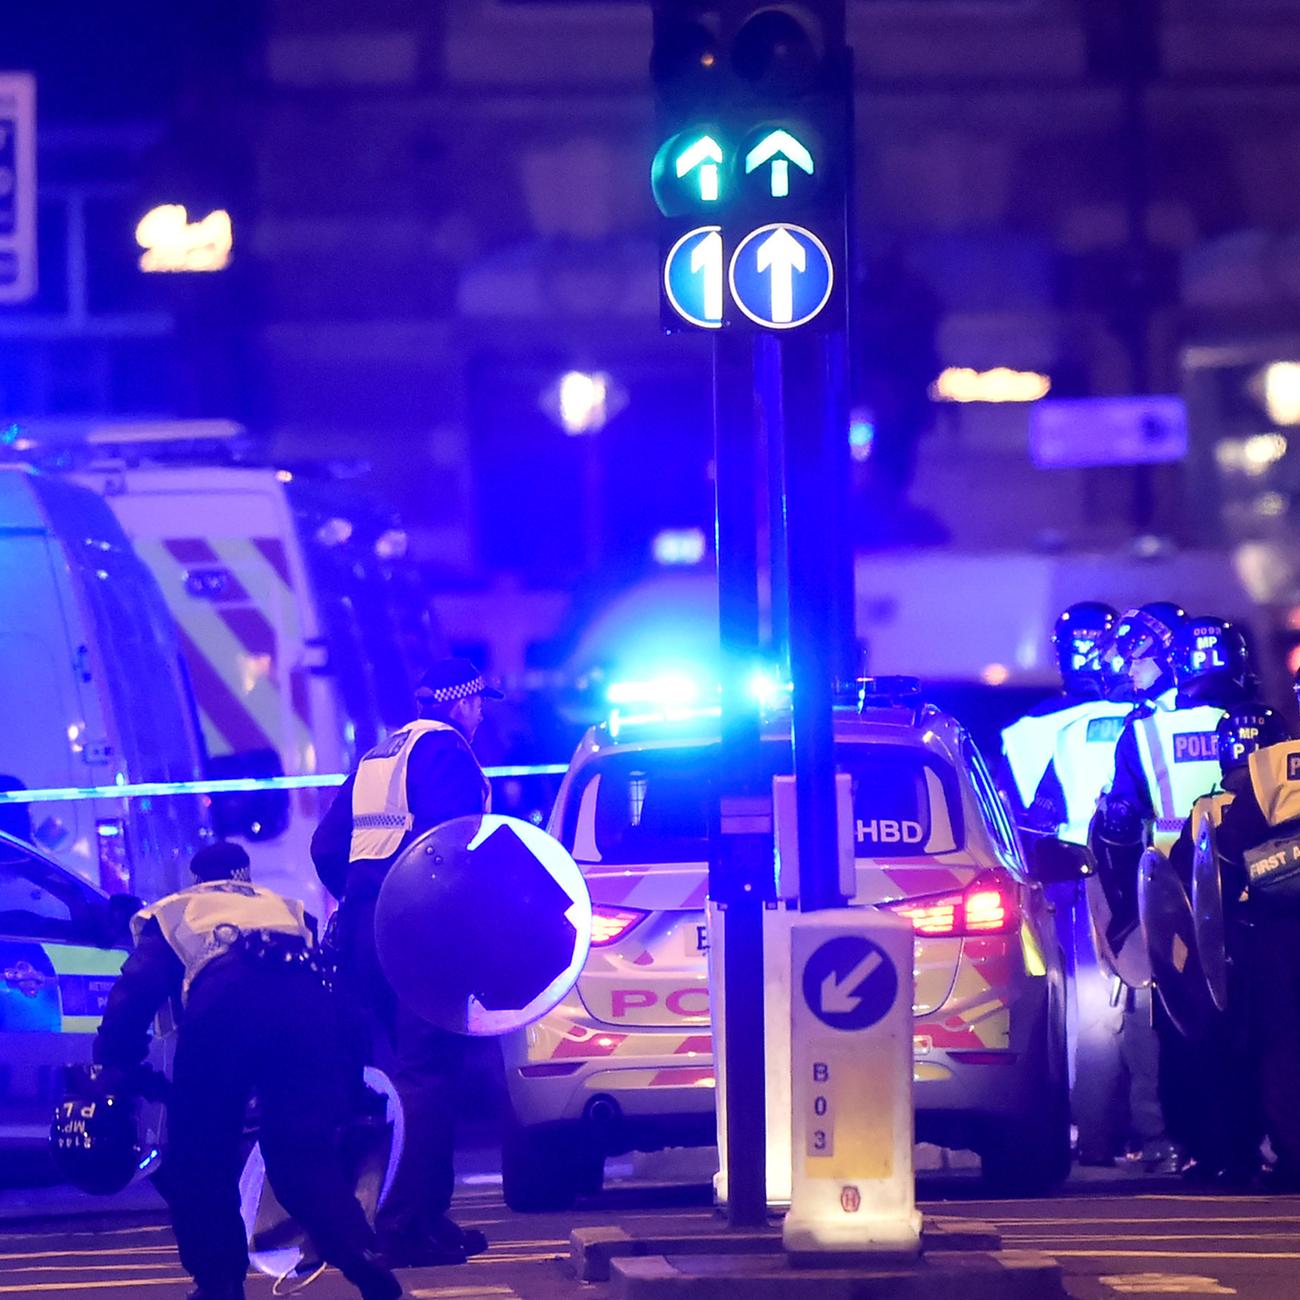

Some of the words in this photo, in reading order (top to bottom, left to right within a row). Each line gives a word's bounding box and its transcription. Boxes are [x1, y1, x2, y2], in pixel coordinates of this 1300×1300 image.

[1196, 636, 1218, 650] MP
[1239, 727, 1259, 739] MP
[1176, 735, 1218, 759] POLI
[1250, 851, 1287, 878] FIRST
[64, 1119, 86, 1134] MP
